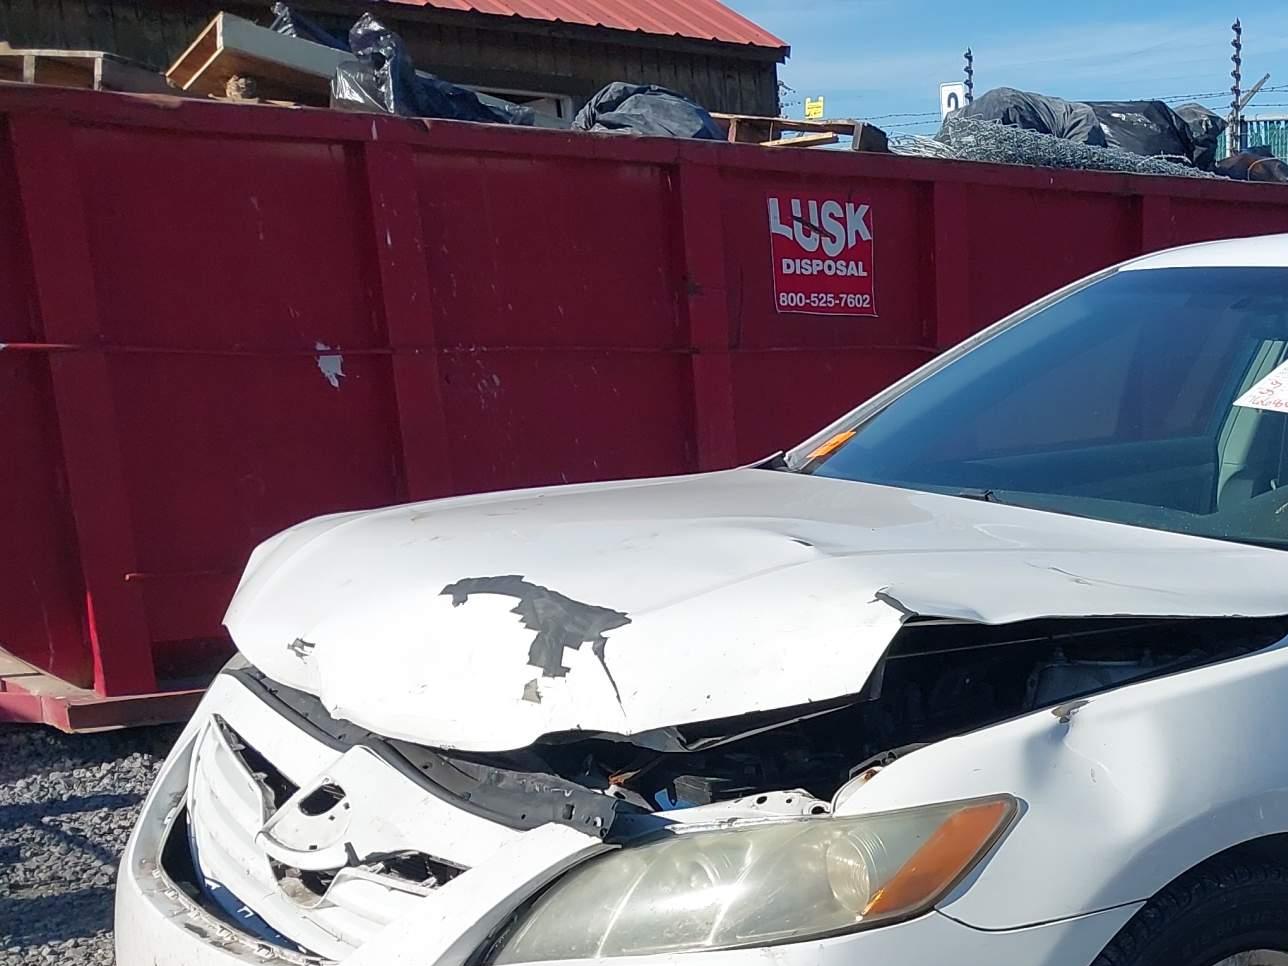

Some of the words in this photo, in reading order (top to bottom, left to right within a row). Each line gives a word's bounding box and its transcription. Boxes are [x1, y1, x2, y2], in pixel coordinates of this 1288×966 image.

[768, 198, 872, 257] LUSK
[782, 258, 868, 277] DISPOSAL
[779, 292, 871, 308] 800-525-7602
